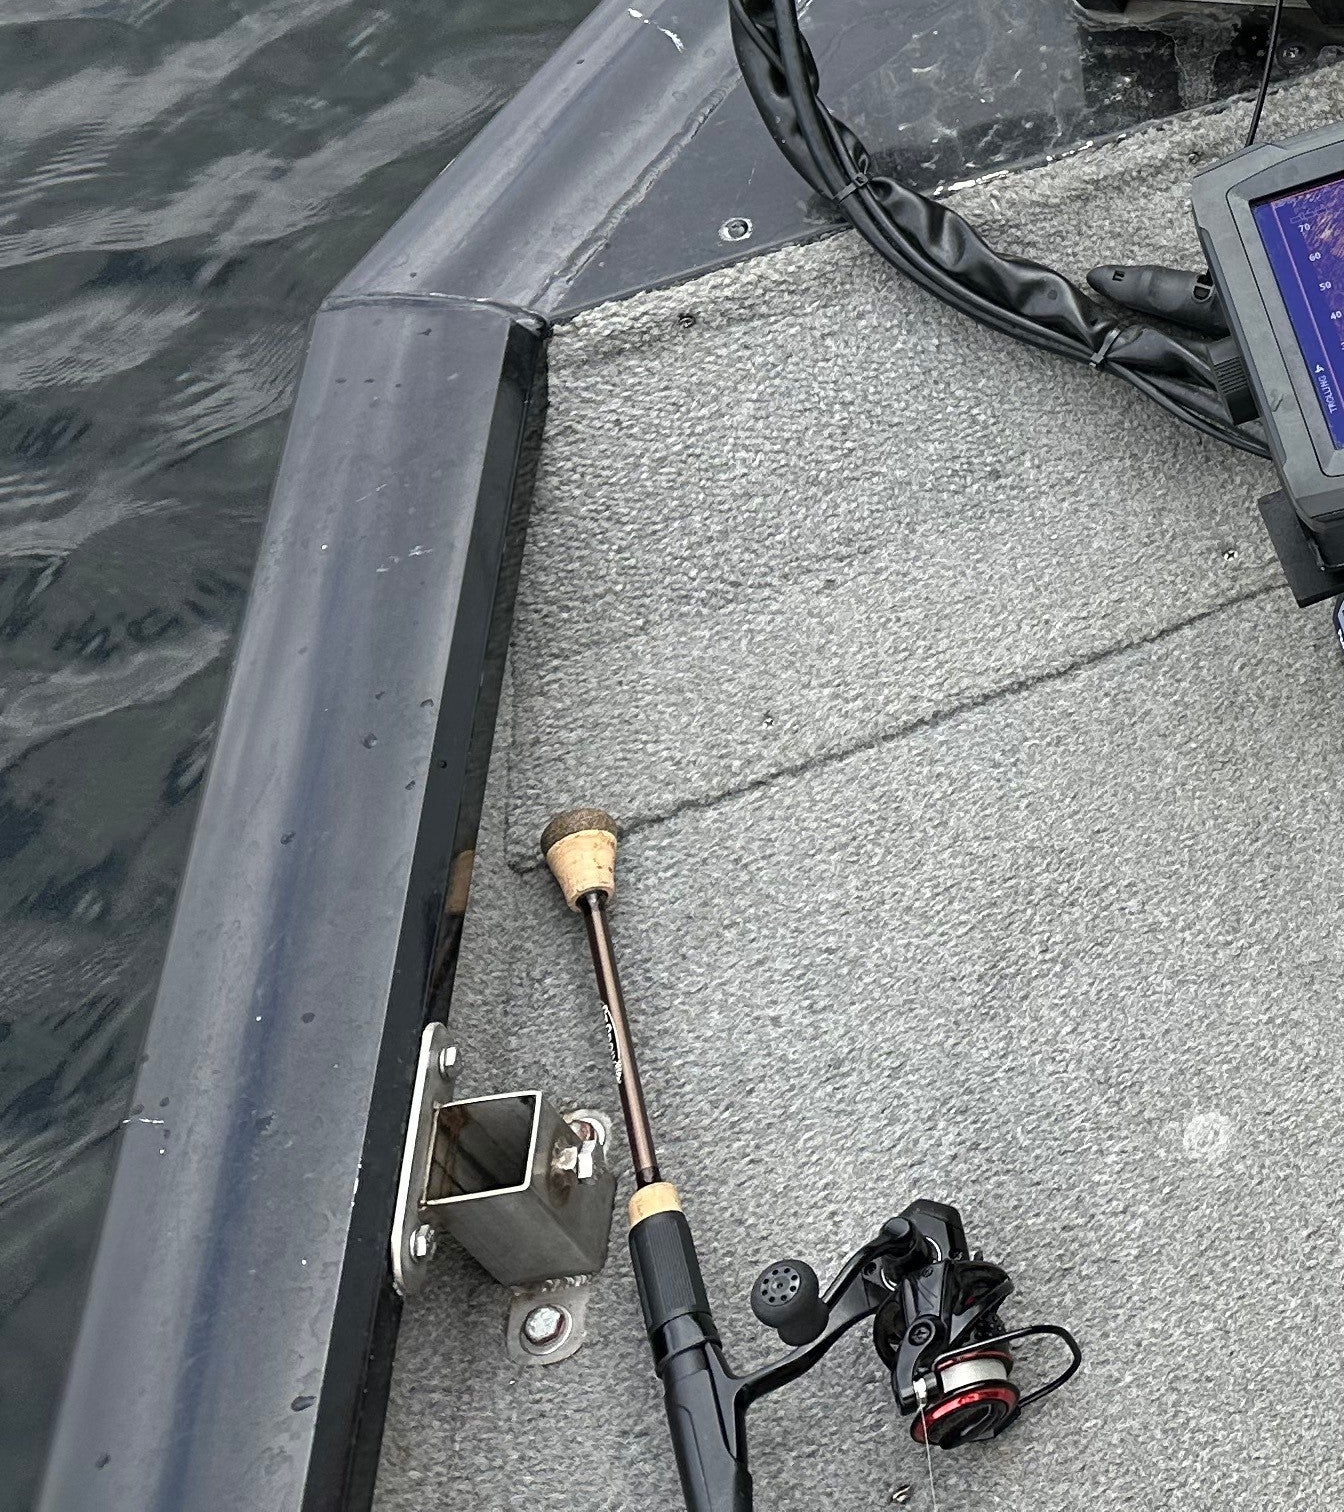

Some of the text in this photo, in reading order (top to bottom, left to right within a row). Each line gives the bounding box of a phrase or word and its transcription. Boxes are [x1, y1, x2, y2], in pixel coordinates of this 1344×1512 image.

[1299, 222, 1311, 232] 70
[1308, 251, 1322, 262] 60
[1319, 280, 1332, 292] 50
[1330, 309, 1342, 321] 40
[1317, 374, 1337, 414] TROLLING
